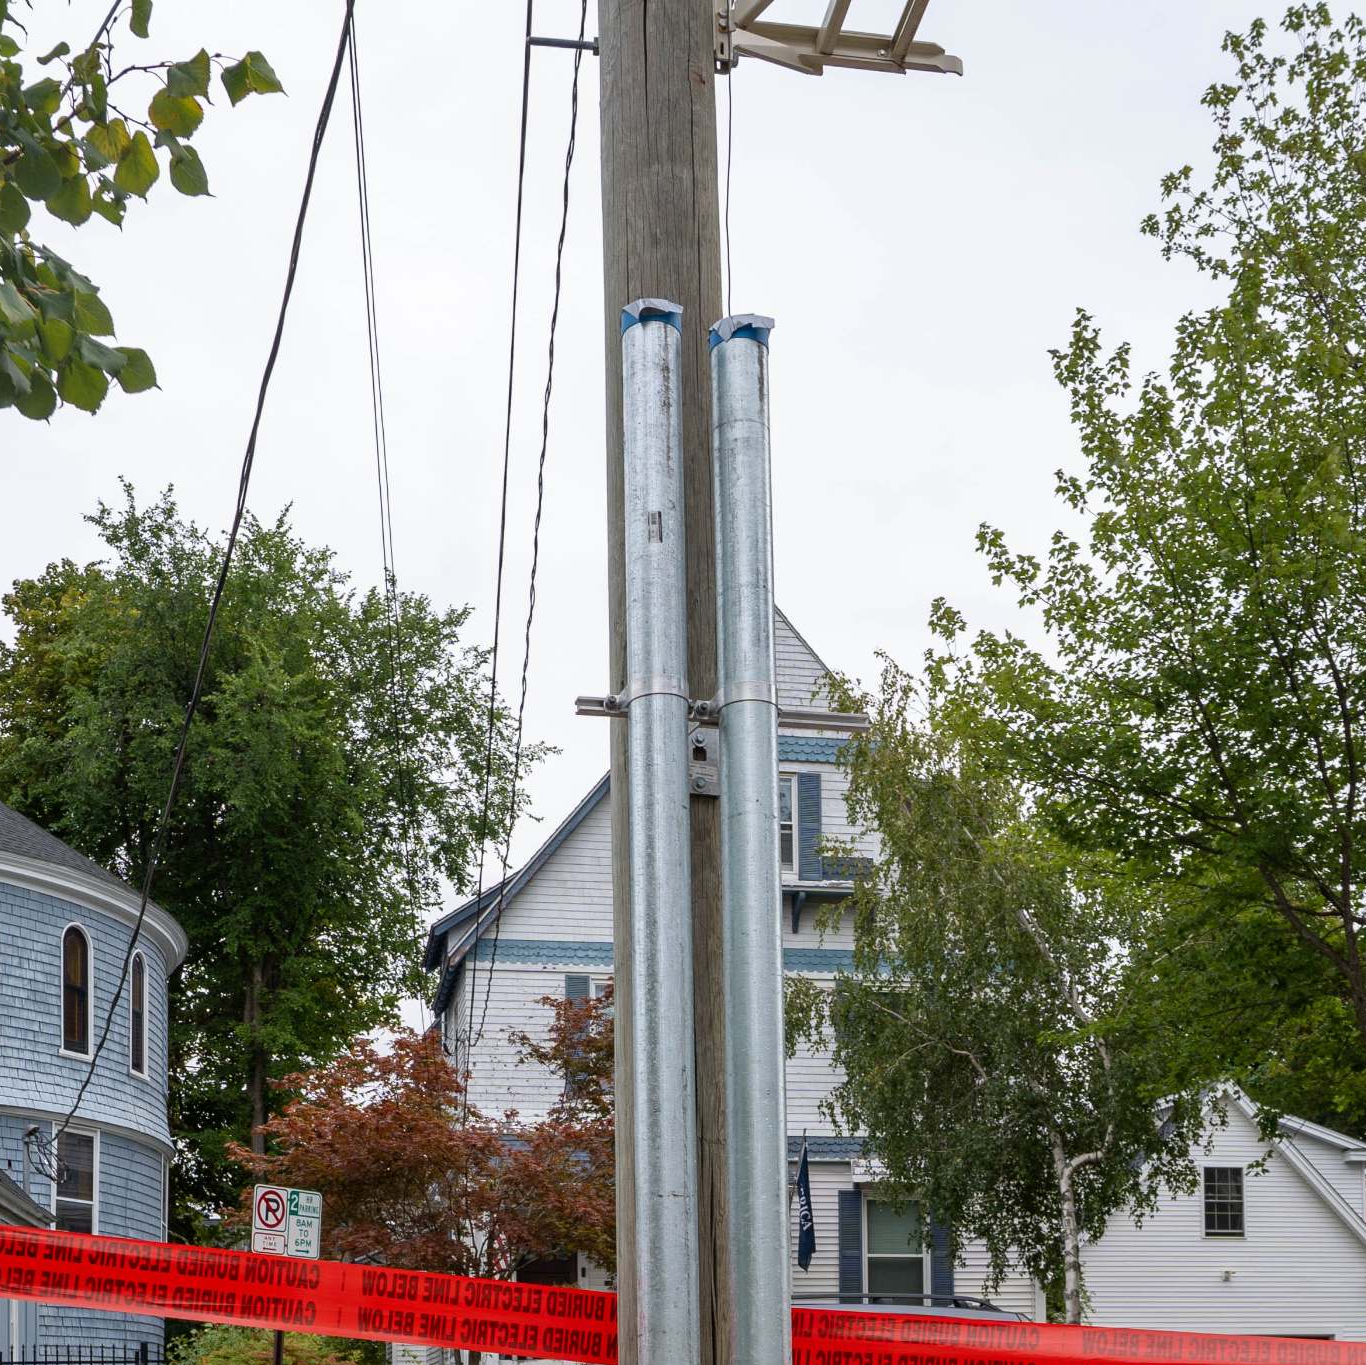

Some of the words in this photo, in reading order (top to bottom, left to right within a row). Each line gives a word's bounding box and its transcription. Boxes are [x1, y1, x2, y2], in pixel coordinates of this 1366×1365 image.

[291, 1194, 299, 1211] 2
[296, 1219, 313, 1228] 8AM
[299, 1229, 308, 1238] TO
[295, 1239, 312, 1248] 6PM
